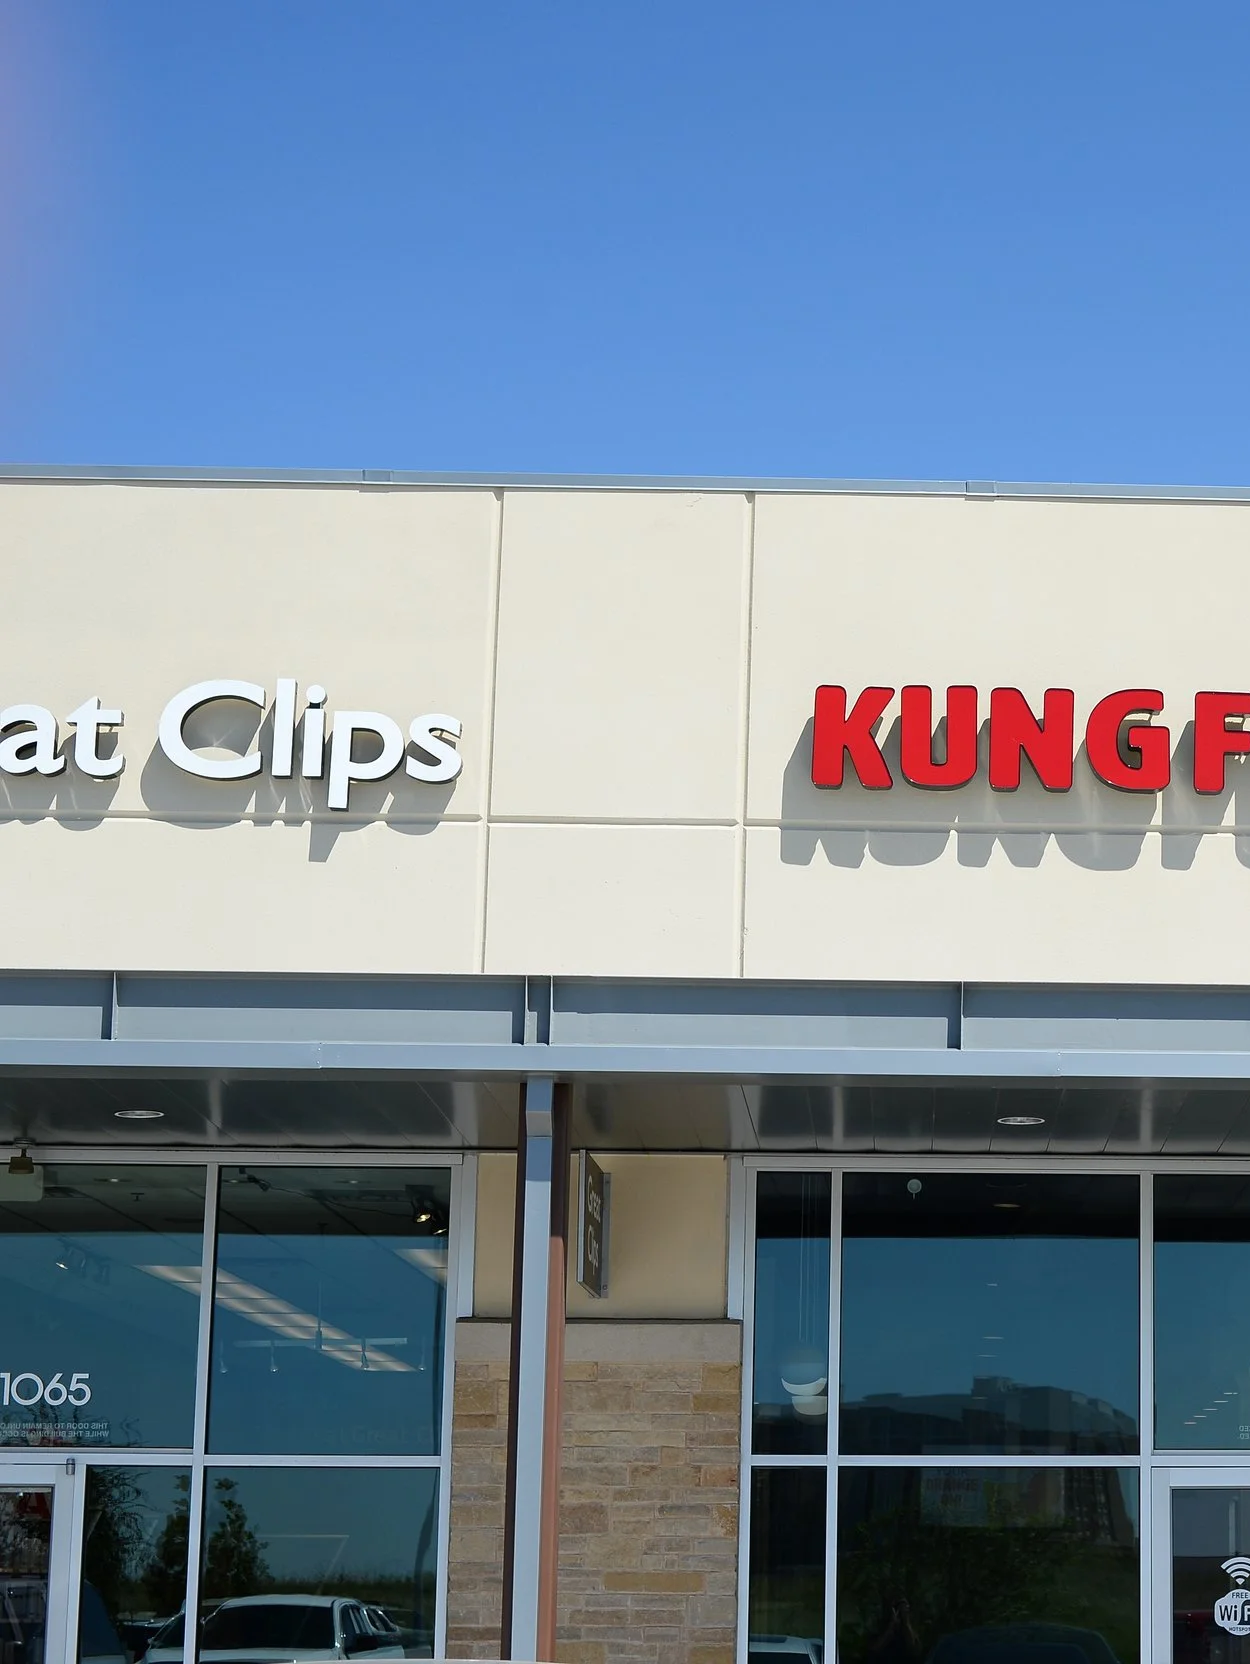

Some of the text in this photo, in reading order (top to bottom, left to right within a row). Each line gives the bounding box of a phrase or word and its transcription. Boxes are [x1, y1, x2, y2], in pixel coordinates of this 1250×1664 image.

[157, 678, 463, 810] Clips
[812, 684, 1171, 793] KUNG
[0, 1372, 92, 1406] 1065
